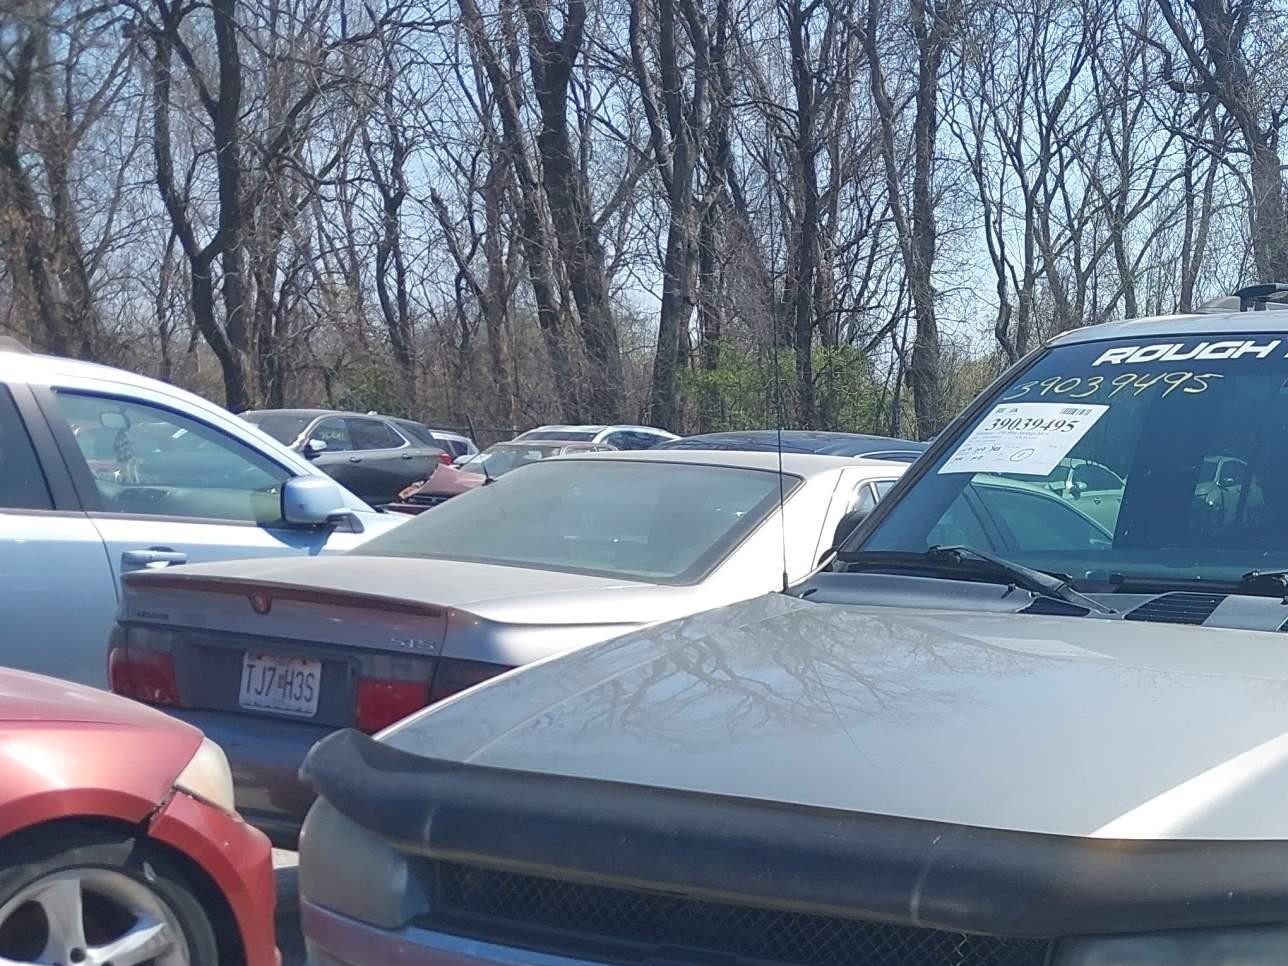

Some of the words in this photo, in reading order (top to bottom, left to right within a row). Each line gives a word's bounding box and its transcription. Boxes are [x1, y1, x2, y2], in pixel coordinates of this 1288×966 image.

[1092, 339, 1282, 367] ROUGH
[1003, 371, 1224, 401] 39039495
[985, 416, 1080, 433] 39039495
[246, 663, 277, 697] TJ7
[282, 668, 315, 703] H3S
